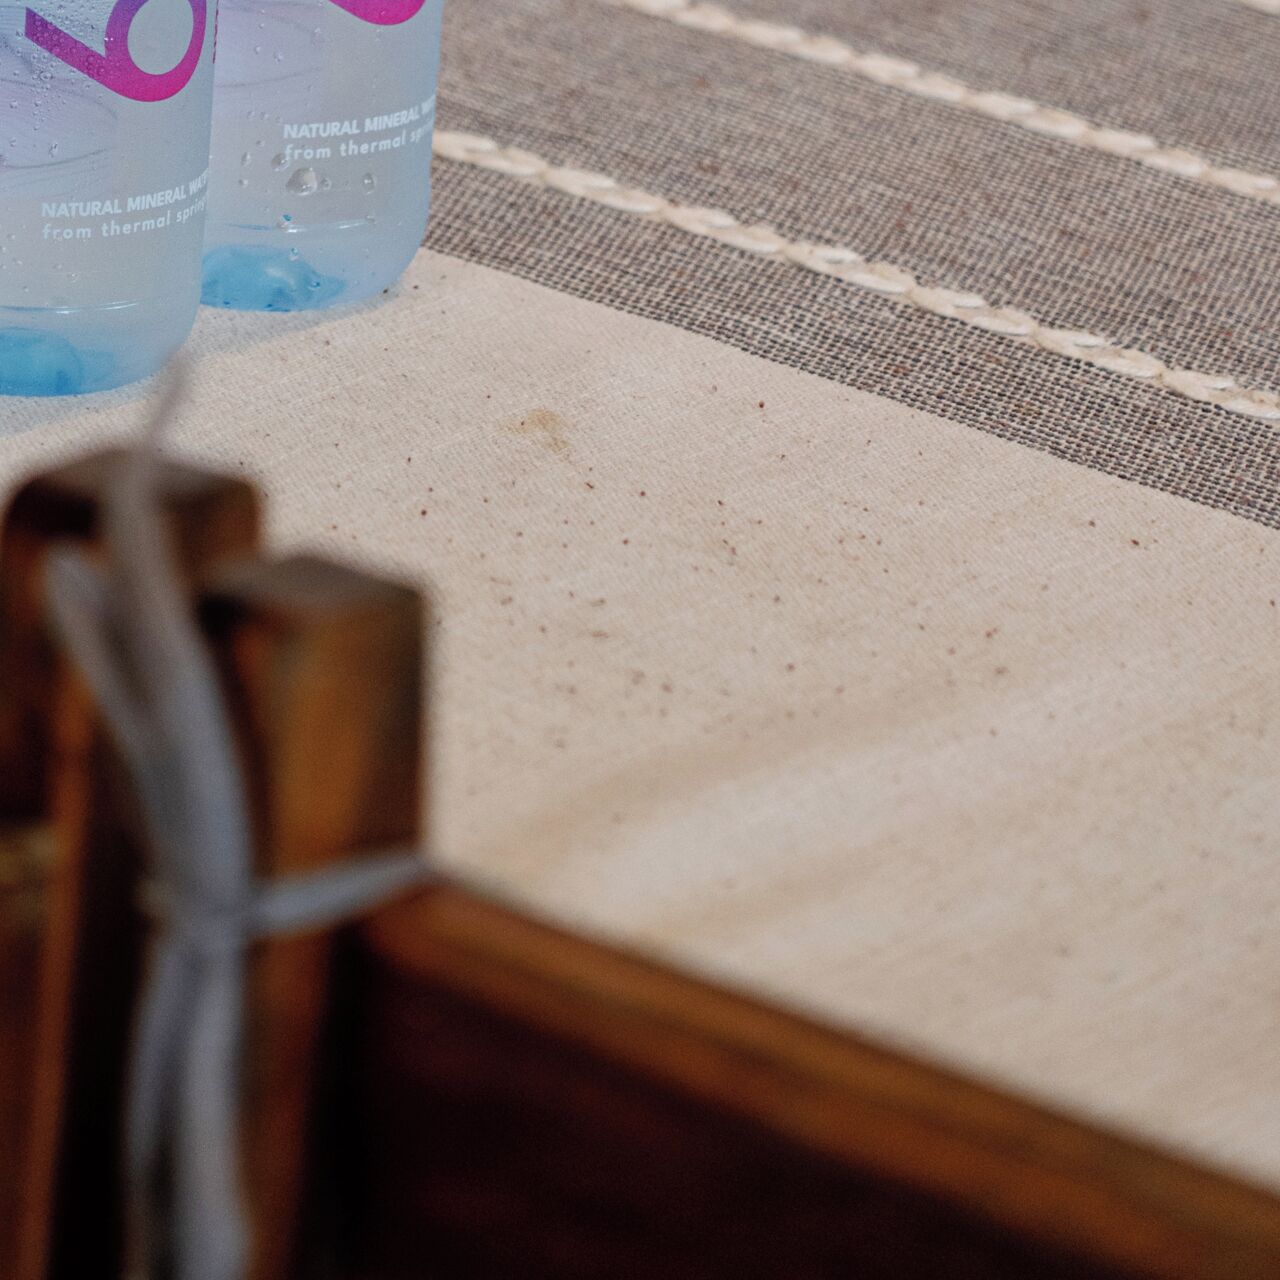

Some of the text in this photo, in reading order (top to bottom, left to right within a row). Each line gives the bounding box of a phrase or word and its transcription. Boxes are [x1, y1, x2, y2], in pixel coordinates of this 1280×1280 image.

[283, 119, 360, 139] NATURAL
[364, 105, 419, 134] MINERAL
[284, 143, 332, 162] from
[339, 129, 406, 157] thermal
[41, 198, 122, 219] NATURAL
[127, 184, 187, 213] MINERAL
[42, 223, 92, 240] from
[101, 210, 170, 238] thermal
